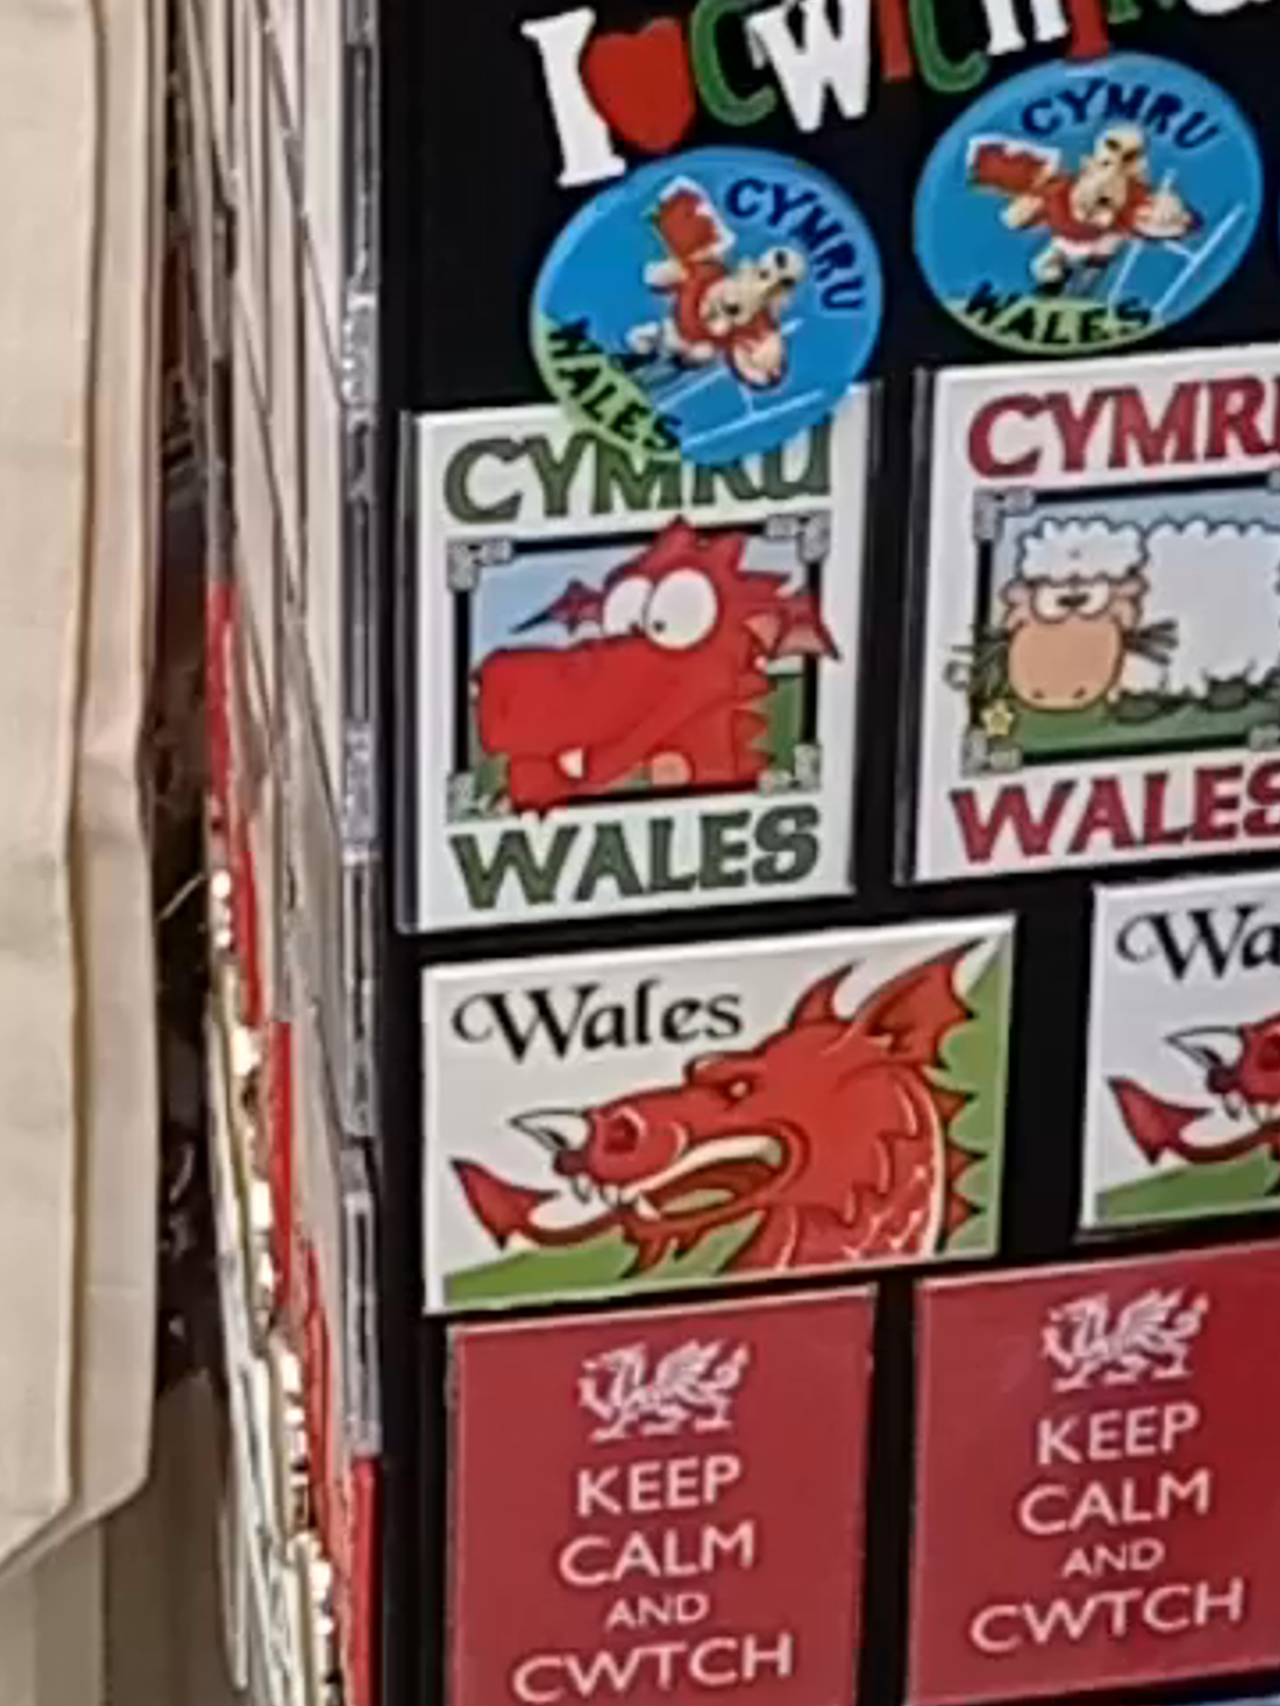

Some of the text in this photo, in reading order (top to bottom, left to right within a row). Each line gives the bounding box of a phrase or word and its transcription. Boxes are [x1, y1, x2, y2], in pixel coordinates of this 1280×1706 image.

[522, 8, 625, 187] I
[1019, 74, 1220, 155] CYMRU
[723, 174, 867, 315] CYMRU
[961, 280, 1157, 349] WALES
[546, 319, 683, 454] WALES
[446, 804, 822, 912] WALES
[451, 974, 746, 1061] Wales
[1037, 1401, 1202, 1466] KEEP
[576, 1455, 743, 1518] KEEP
[1019, 1469, 1212, 1537] CALM
[558, 1521, 758, 1587] CALM
[1061, 1539, 1166, 1580] AND
[604, 1593, 710, 1635] AND
[969, 1579, 1246, 1656] CWTCH
[513, 1633, 796, 1705] CWTCH
